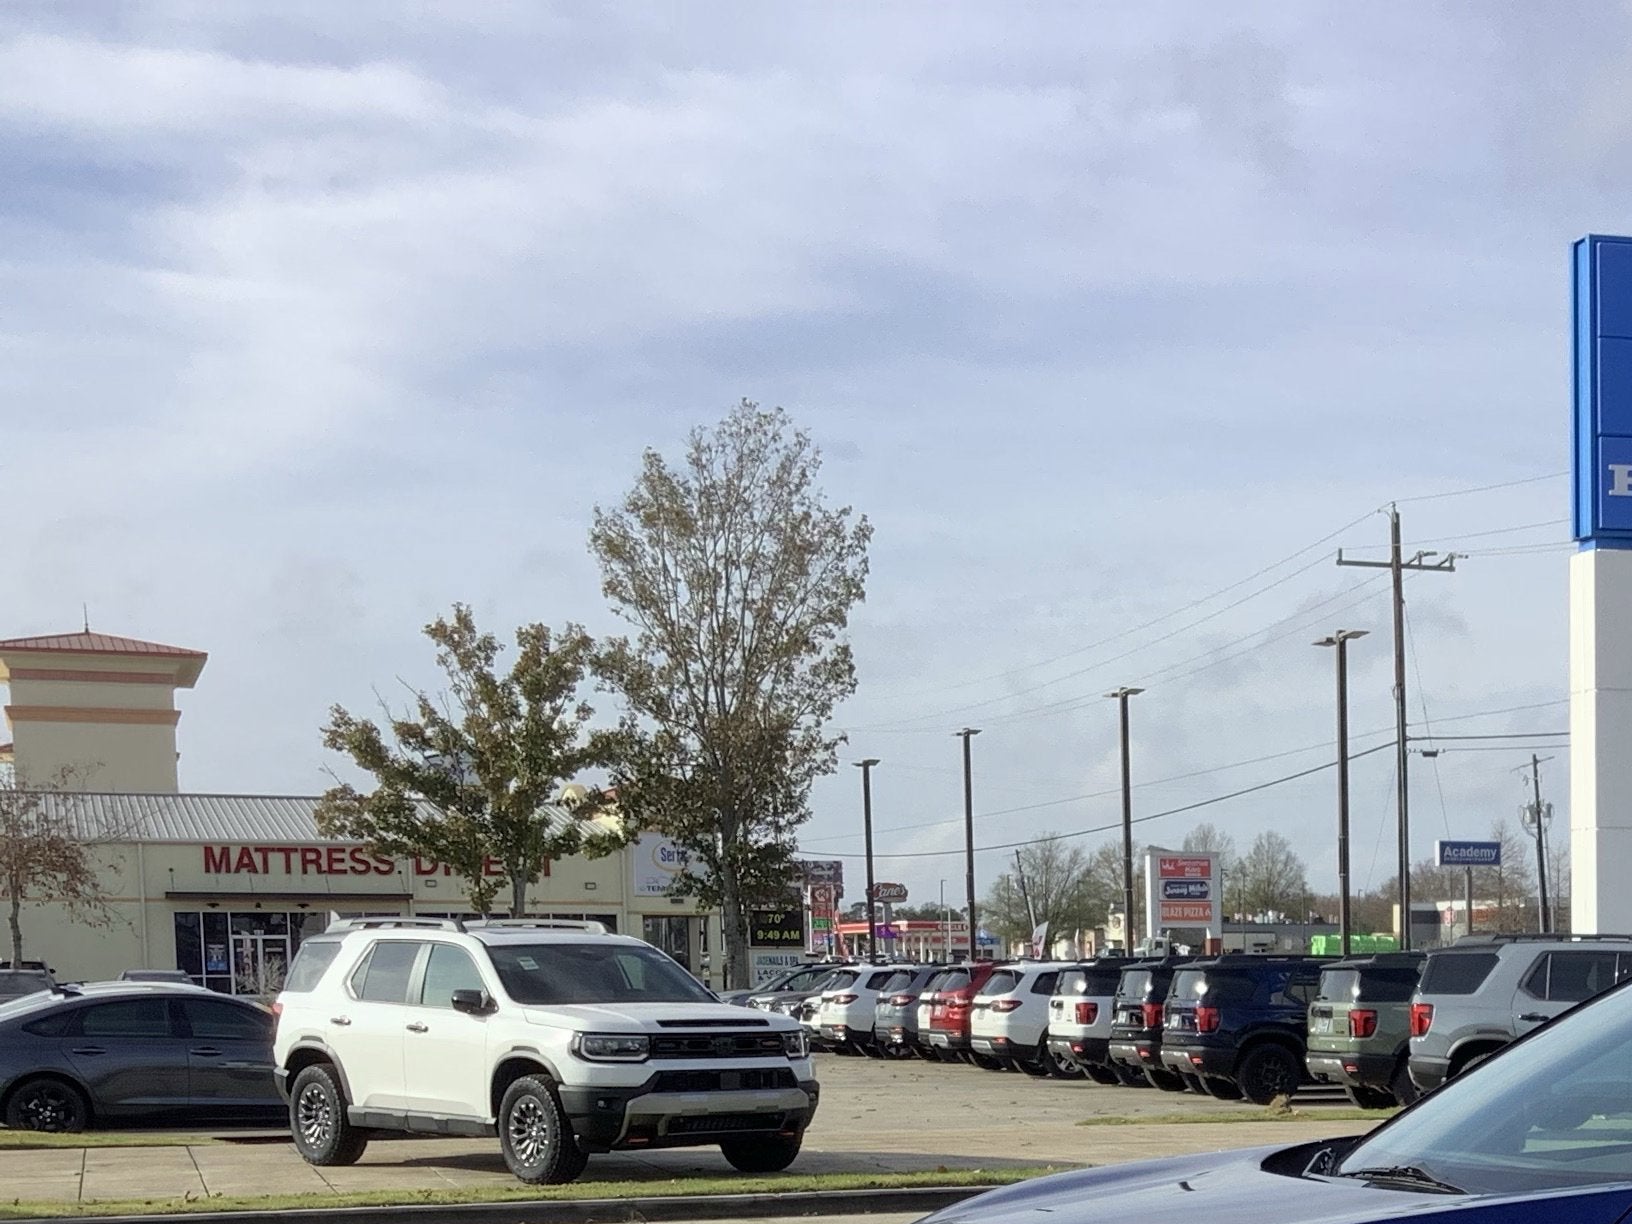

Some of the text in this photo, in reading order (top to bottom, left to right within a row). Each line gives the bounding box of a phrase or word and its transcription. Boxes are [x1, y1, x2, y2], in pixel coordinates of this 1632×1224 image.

[1443, 846, 1497, 860] Academy
[203, 846, 395, 876] MATTRESS
[757, 930, 800, 940] 9:49 AM
